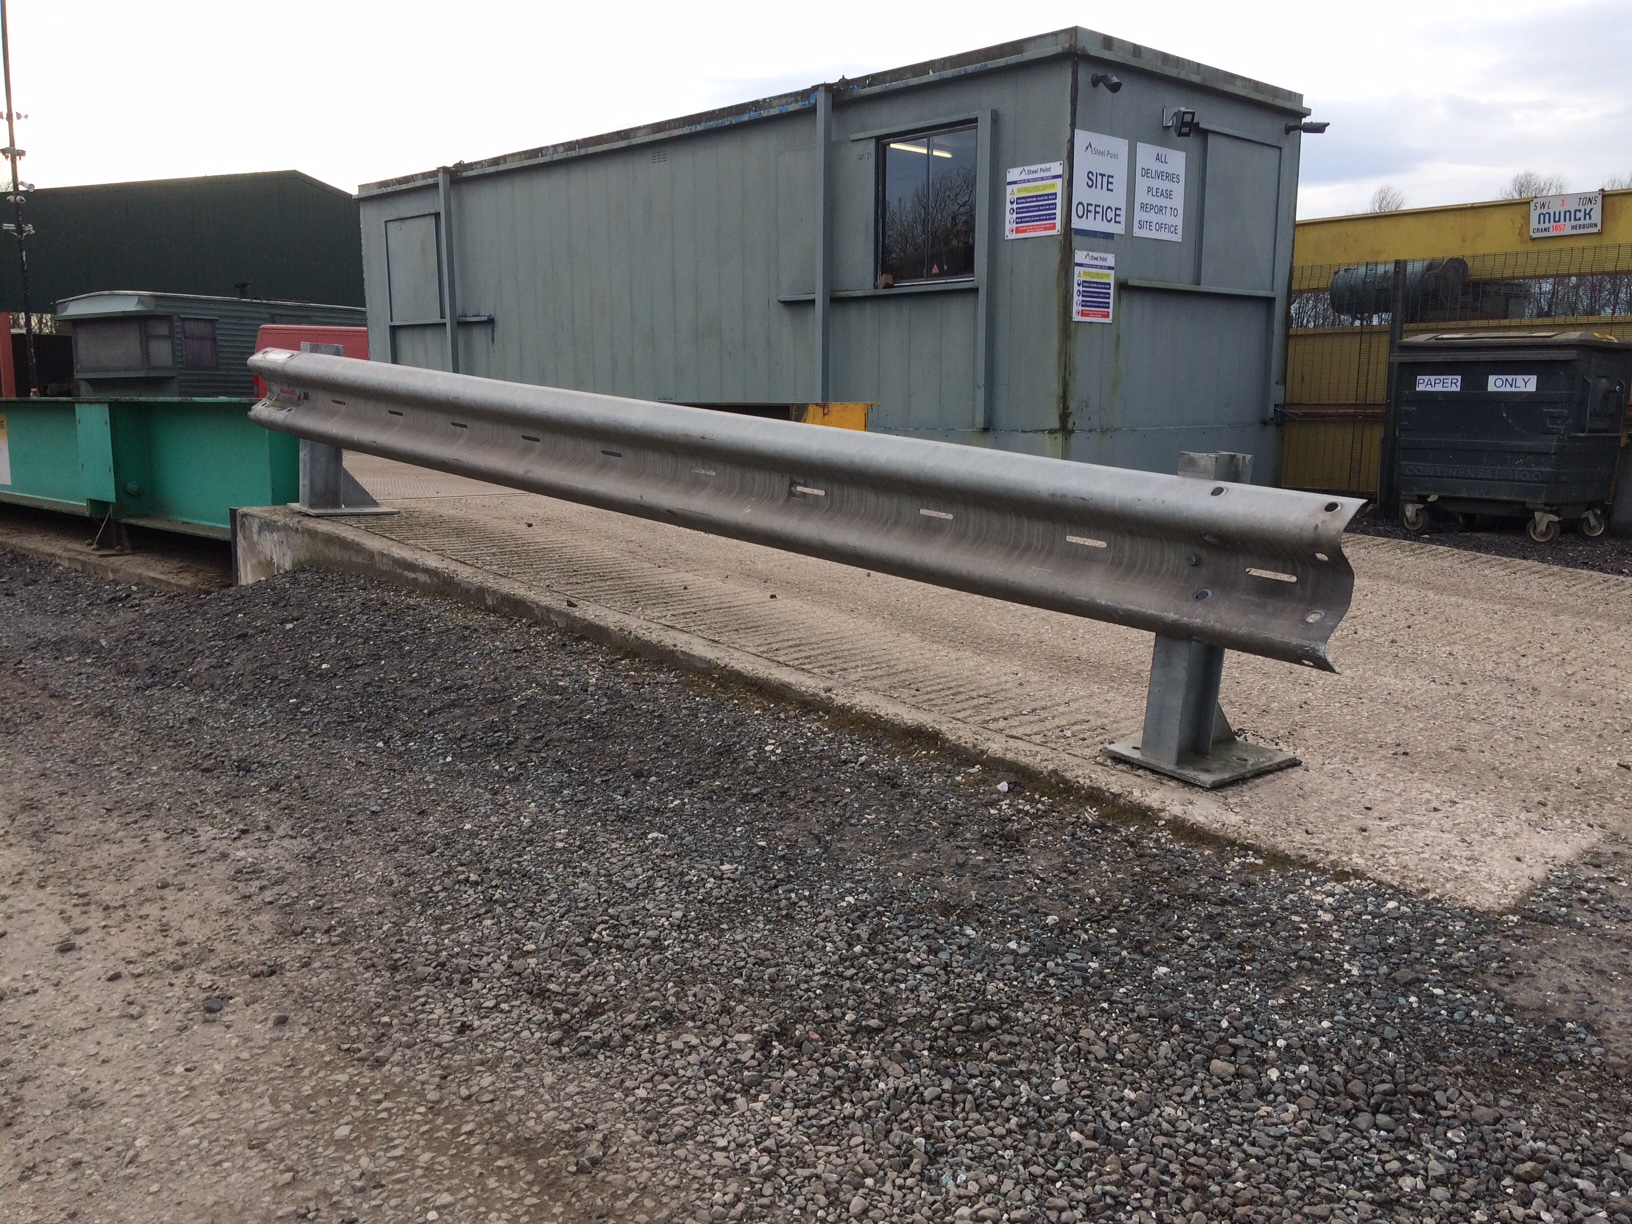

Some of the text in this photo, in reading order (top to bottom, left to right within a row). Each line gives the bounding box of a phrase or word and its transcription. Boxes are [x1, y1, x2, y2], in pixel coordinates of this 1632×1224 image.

[1093, 147, 1119, 160] Steel Point
[1155, 152, 1168, 164] ALL
[1086, 170, 1114, 192] SITE
[1141, 167, 1180, 184] DELIVERIES
[1146, 186, 1173, 200] PLEASE
[1140, 202, 1178, 217] REPORT TO
[1533, 200, 1551, 211] SWL
[1577, 195, 1598, 207] TONS
[1075, 201, 1121, 224] OFFICE
[1538, 208, 1593, 225] MUNCK
[1137, 219, 1178, 235] SITE OFFICE
[1532, 222, 1598, 234] CRANE 1657 HEBBURN
[1417, 377, 1531, 389] PAPER ONLY
